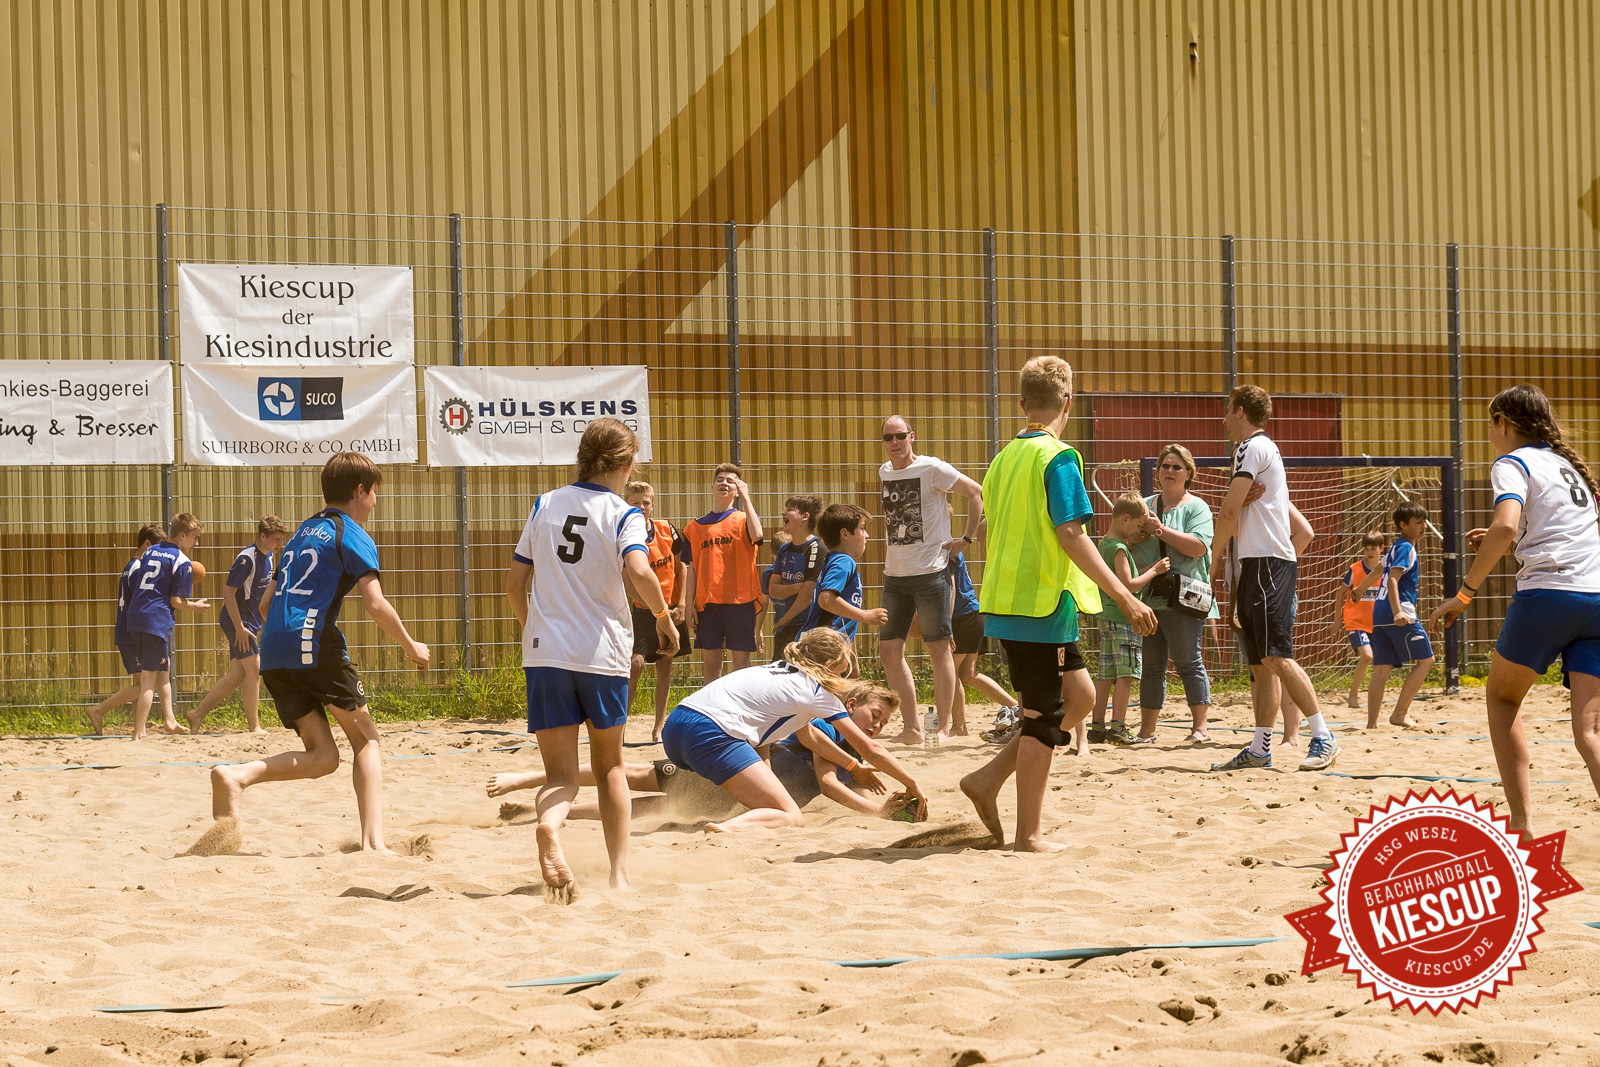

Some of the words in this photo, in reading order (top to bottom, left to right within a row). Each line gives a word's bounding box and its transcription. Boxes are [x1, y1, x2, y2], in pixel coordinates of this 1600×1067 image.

[240, 274, 354, 305] Kiescup
[282, 309, 314, 325] der
[205, 334, 393, 358] Kiesindustrie
[0, 379, 149, 401] nkies-Baggerei
[305, 392, 336, 406] SUCO
[448, 407, 465, 427] H
[479, 398, 638, 417] HÜLSKENS
[48, 418, 65, 436] &
[75, 413, 160, 438] Bresser
[478, 420, 542, 435] GMBH
[550, 420, 565, 434] &
[201, 440, 298, 454] SUHRBORG
[302, 441, 314, 454] &
[350, 438, 401, 453] GMBH
[1559, 467, 1589, 508] 8
[300, 526, 332, 544] Borken
[557, 514, 588, 565] 5
[139, 559, 162, 591] 2
[275, 548, 319, 597] 32
